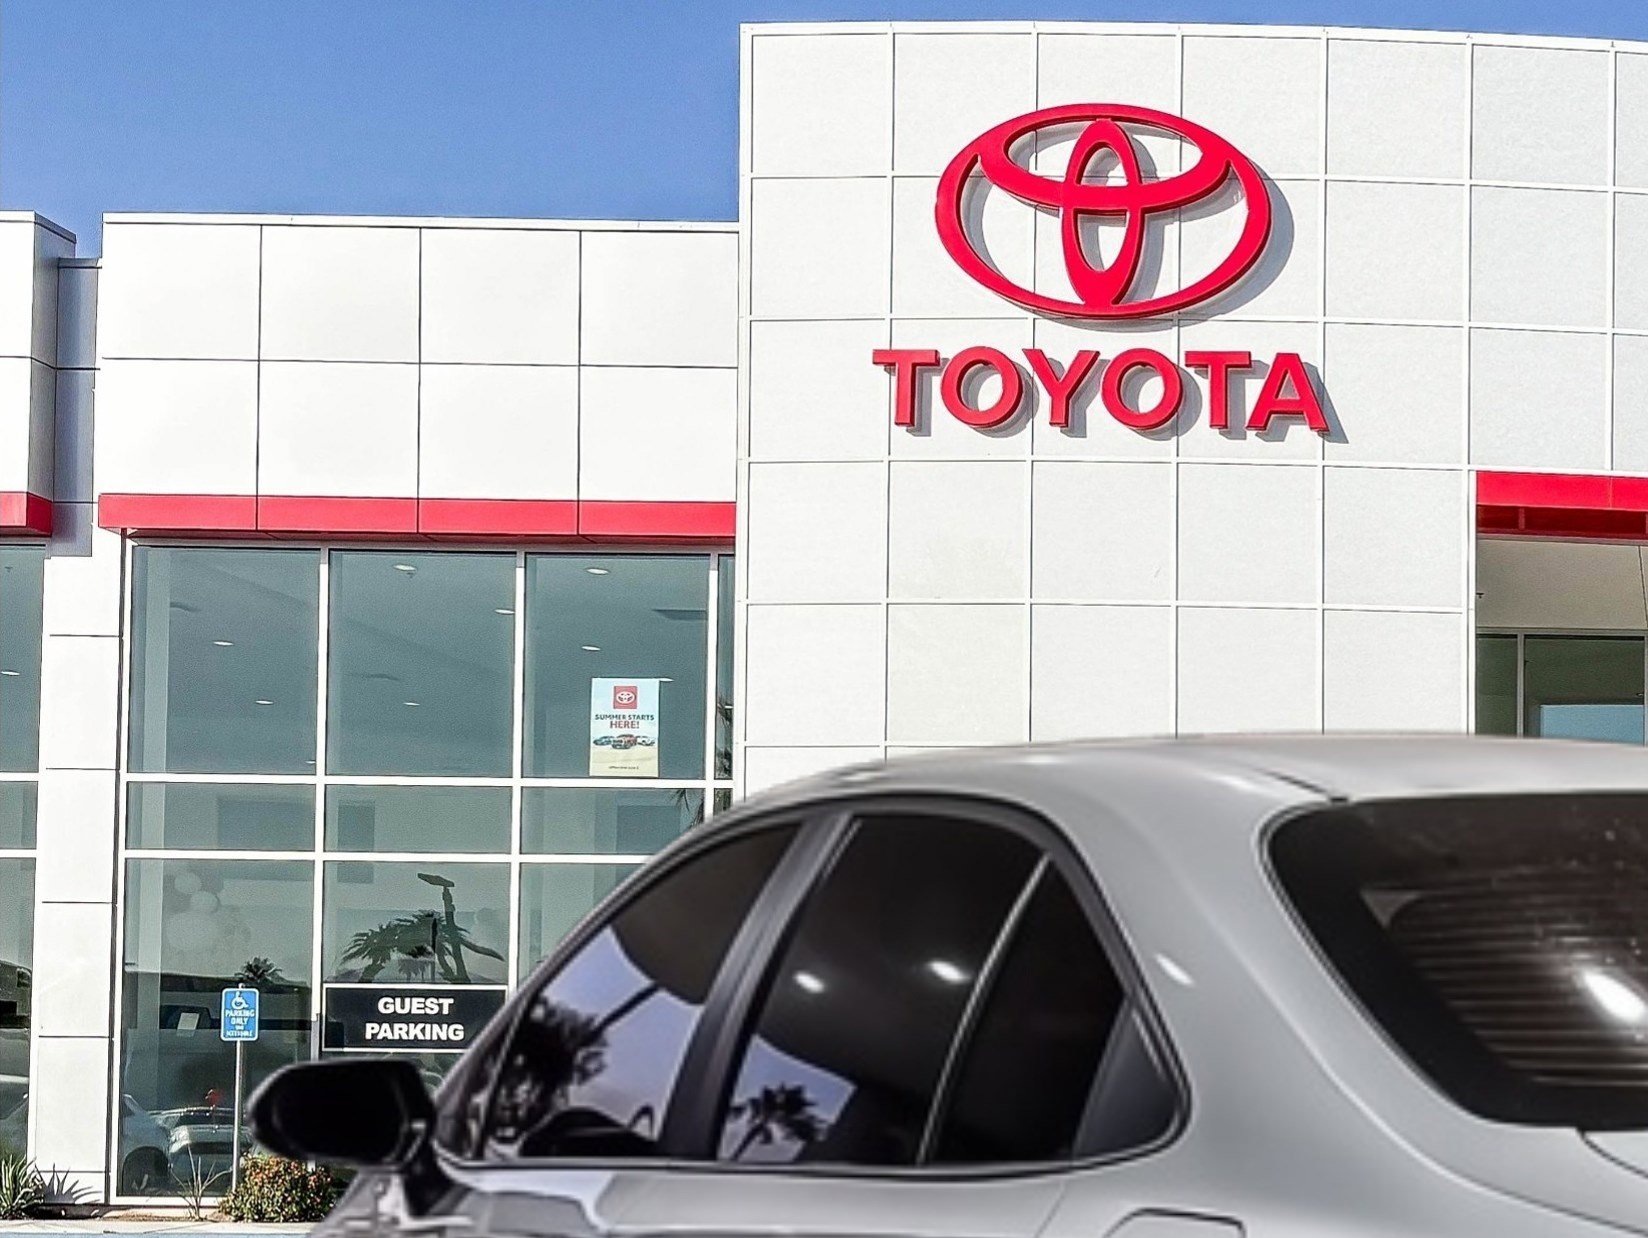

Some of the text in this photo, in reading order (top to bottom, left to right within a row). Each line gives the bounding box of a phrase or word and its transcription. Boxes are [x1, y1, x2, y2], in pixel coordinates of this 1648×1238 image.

[872, 345, 1330, 433] TOYOTA
[609, 721, 640, 729] HERE!
[378, 997, 454, 1015] GUEST
[225, 1009, 255, 1017] PARKING
[230, 1017, 249, 1025] ONLY
[365, 1022, 464, 1041] PARKING
